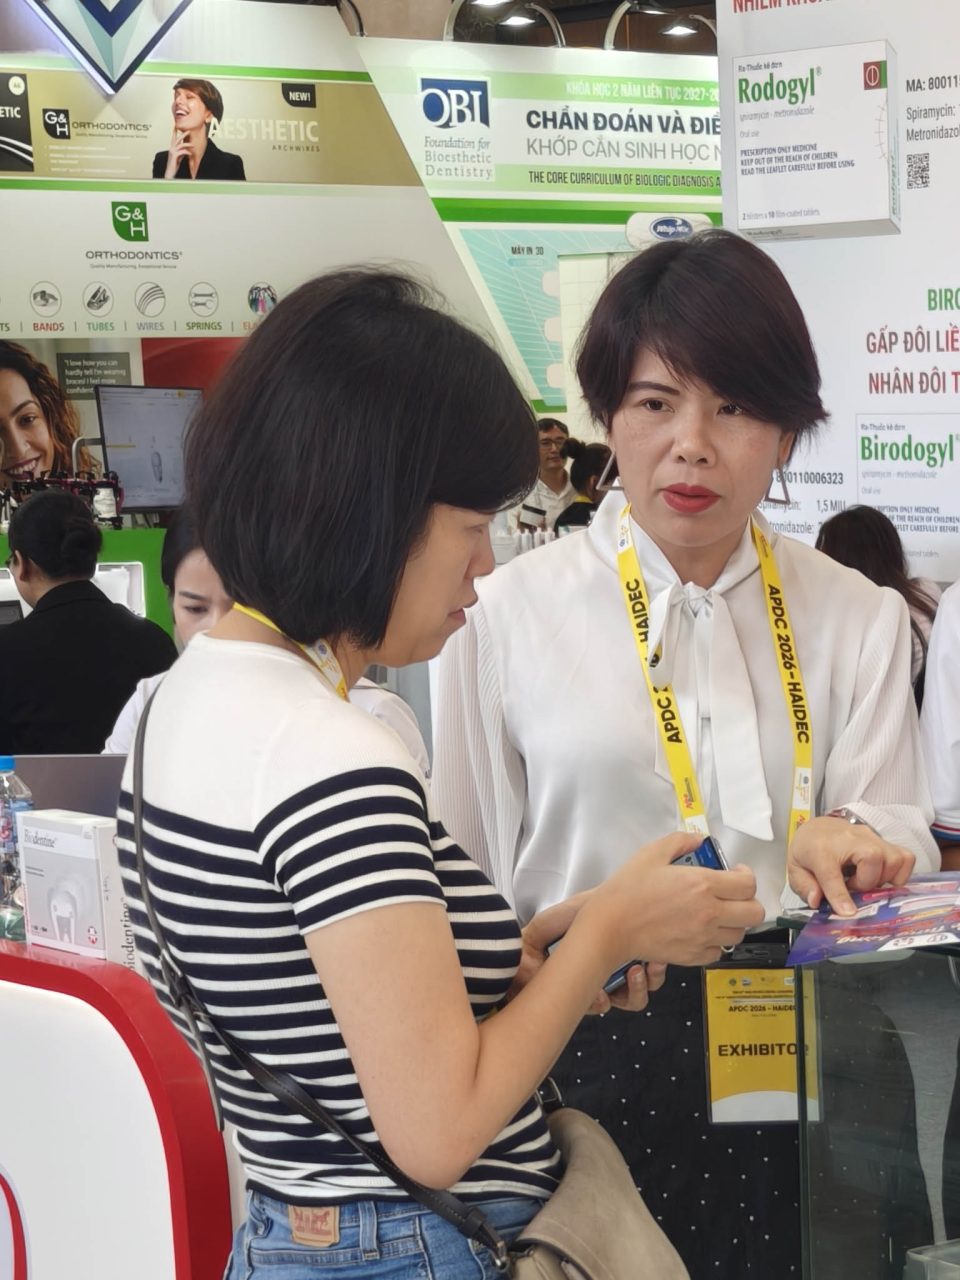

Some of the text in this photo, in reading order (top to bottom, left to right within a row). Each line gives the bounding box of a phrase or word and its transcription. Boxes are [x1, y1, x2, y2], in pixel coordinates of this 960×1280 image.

[612, 84, 619, 96] 2
[906, 78, 926, 93] MA:
[289, 92, 311, 102] NEW!
[526, 105, 588, 131] CHẨN
[594, 108, 653, 133] ĐOÁN
[657, 110, 685, 135] VÀ
[906, 103, 956, 123] Spiramycin:
[208, 117, 319, 142] AESTHETIC
[272, 144, 320, 153] ARCHWIRES
[424, 136, 491, 151] Foundation for
[527, 135, 577, 156] KHỚP
[625, 141, 666, 160] SINH
[671, 143, 710, 164] HỌC
[740, 143, 817, 157] PRESCRIPTION ONLY MEDICINE
[741, 157, 753, 167] KEEP
[754, 157, 766, 166] OUT
[774, 156, 785, 164] THE
[811, 151, 838, 161] CHILDREN
[425, 165, 493, 180] Dentistry
[755, 167, 766, 175] THE
[788, 163, 816, 173] CAREFULLY
[817, 161, 837, 170] BEFORE
[529, 171, 714, 188] THE CORE CURRICULUM OF BIOLOGIC DIAGNOSIS
[33, 322, 65, 332] BANDS
[87, 322, 115, 331] TUBES
[136, 321, 164, 331] WIRES
[186, 321, 223, 331] SPRINGS
[866, 325, 899, 354] GẤP
[903, 325, 931, 353] ĐÔI
[869, 366, 914, 395] NHÂN
[919, 366, 946, 394] ĐÔI
[768, 584, 788, 630] APDC
[776, 633, 795, 671] 2026
[787, 680, 810, 744] HAIDEC
[657, 696, 683, 744] APDC
[728, 1004, 766, 1013] APDC 2026
